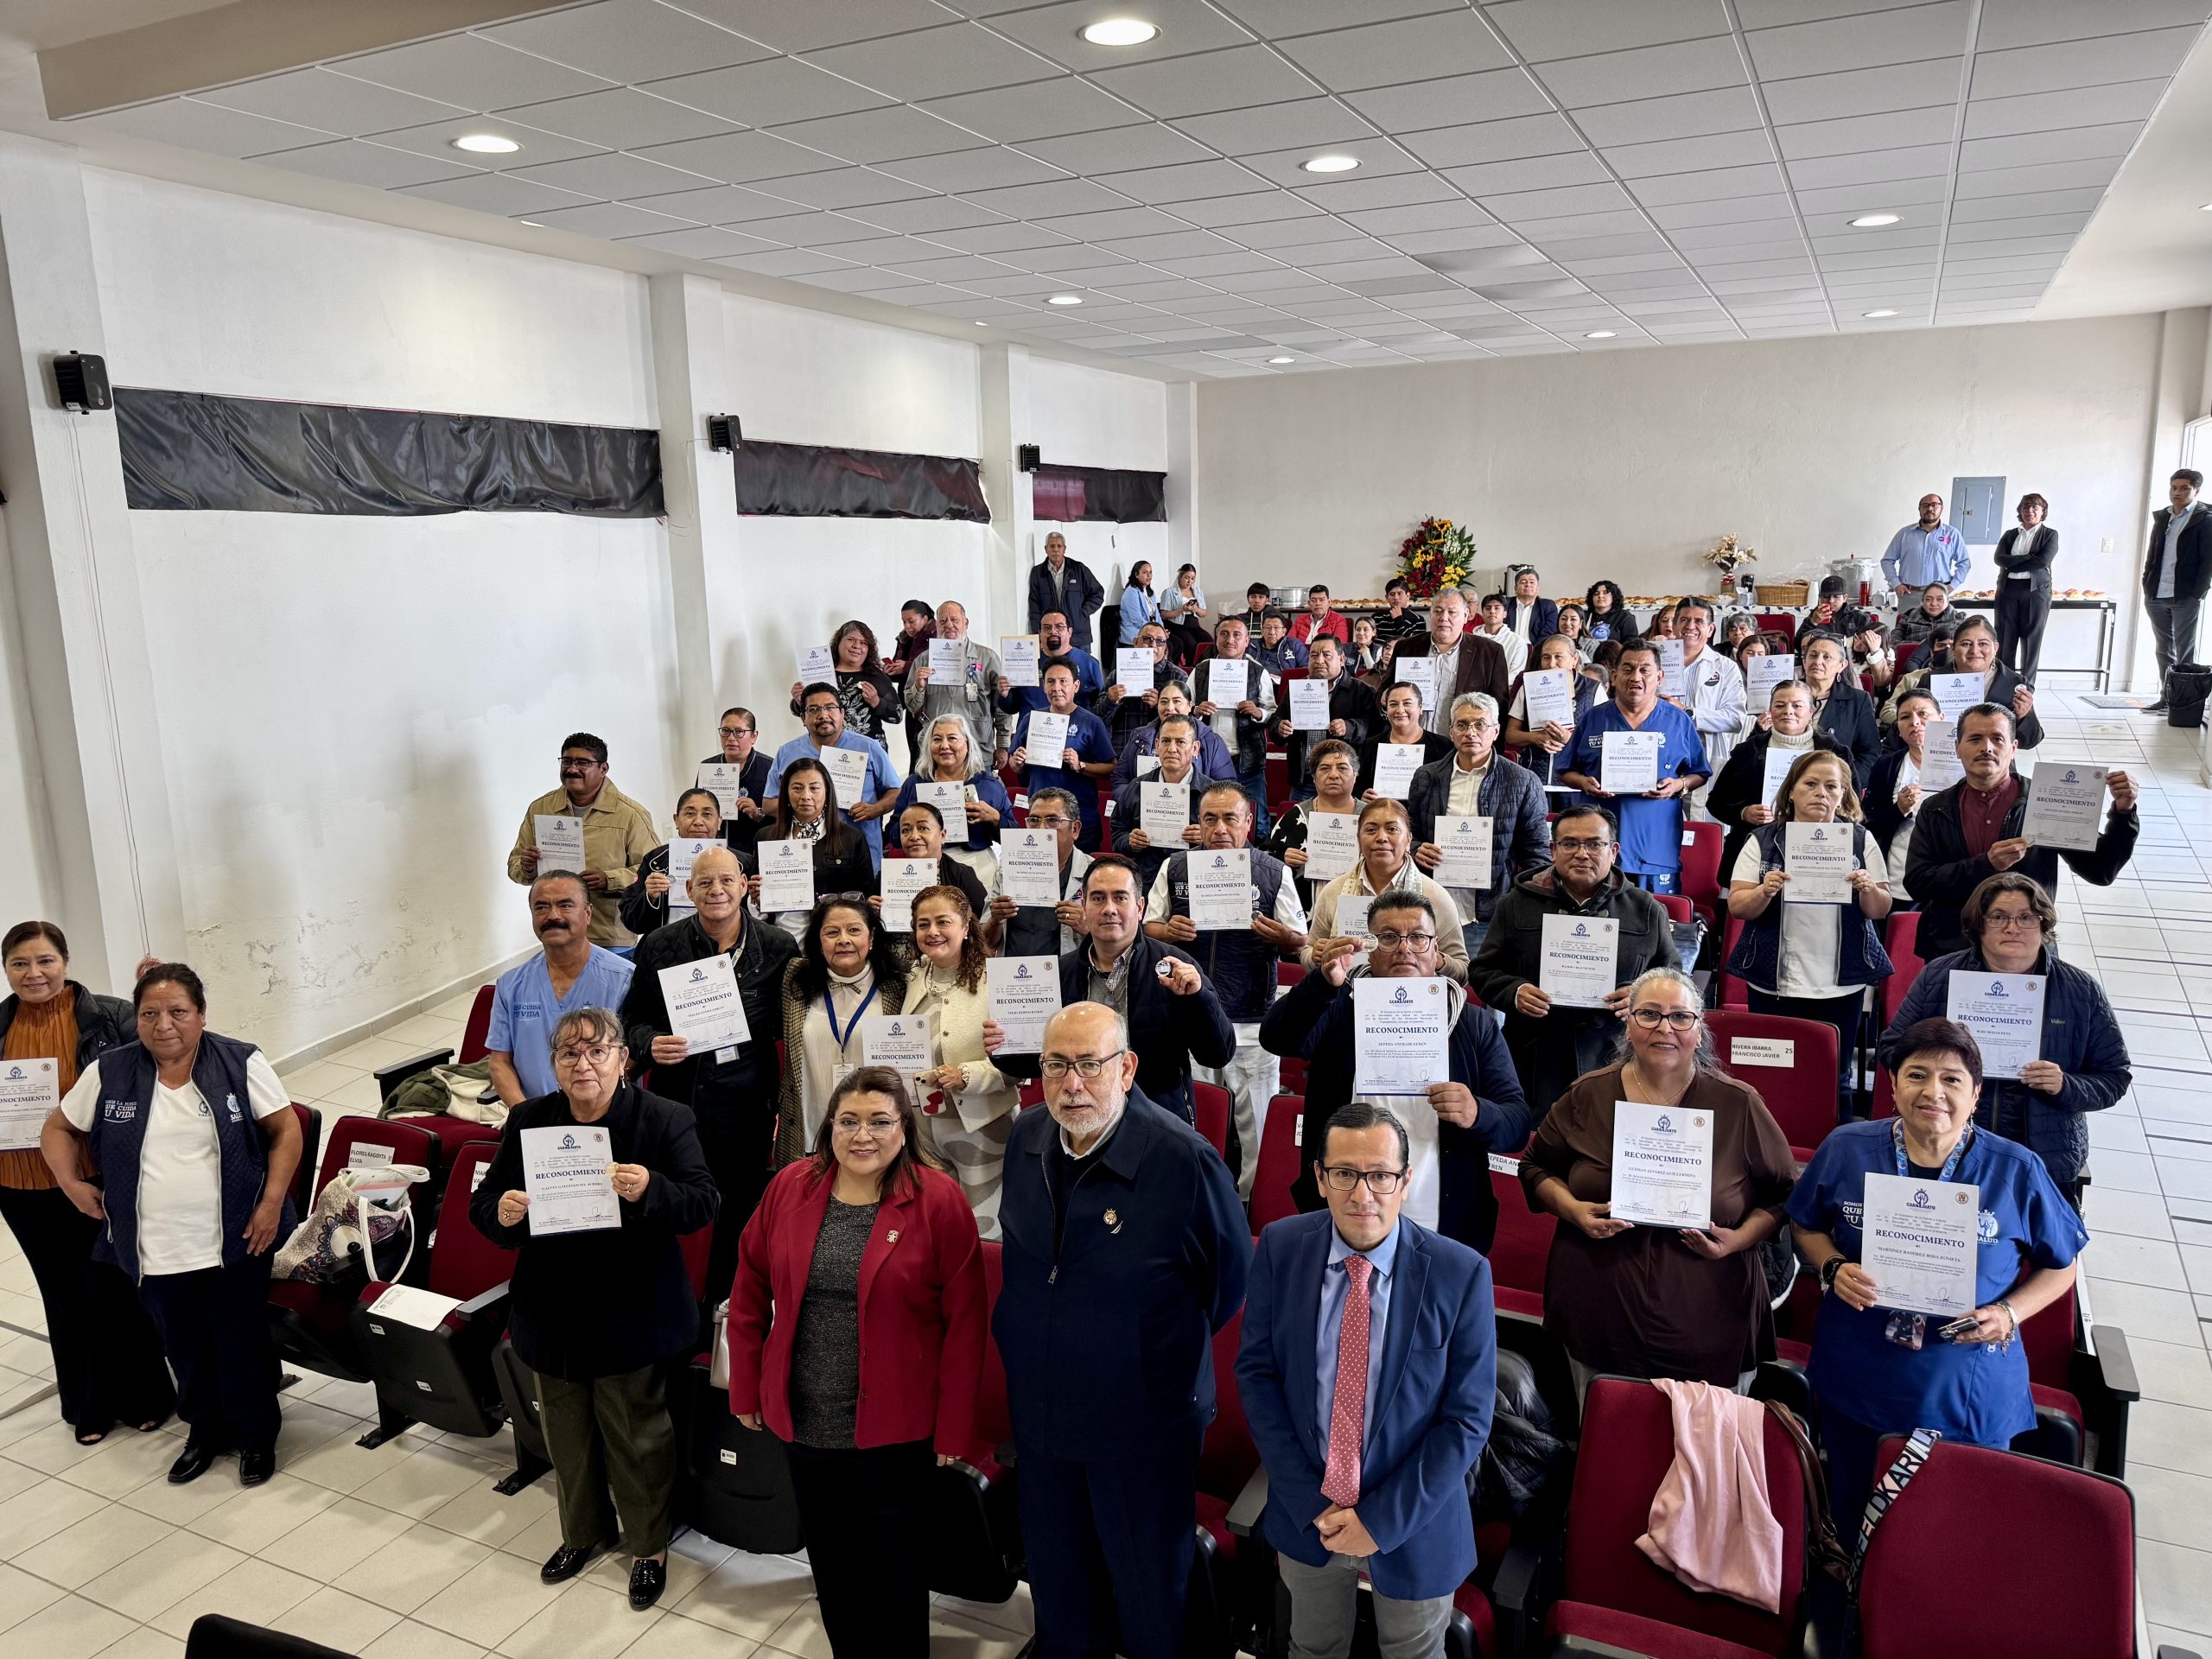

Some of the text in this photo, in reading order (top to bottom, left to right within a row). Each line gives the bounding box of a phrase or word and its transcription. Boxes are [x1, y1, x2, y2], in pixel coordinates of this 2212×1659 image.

[1549, 952, 1609, 963] RECONOCIMIENTO
[675, 992, 732, 1010] RECONOCIMIENTO
[1957, 1014, 2031, 1025] RECONOCIMIENTO
[0, 1095, 51, 1103] ONOCIMIENTO
[1624, 1150, 1701, 1165] RECONOCIMIENTO
[1842, 1206, 1862, 1215] QUE
[1844, 1215, 1859, 1224] TU
[1875, 1229, 1965, 1249] RECONOCIMIENTO
